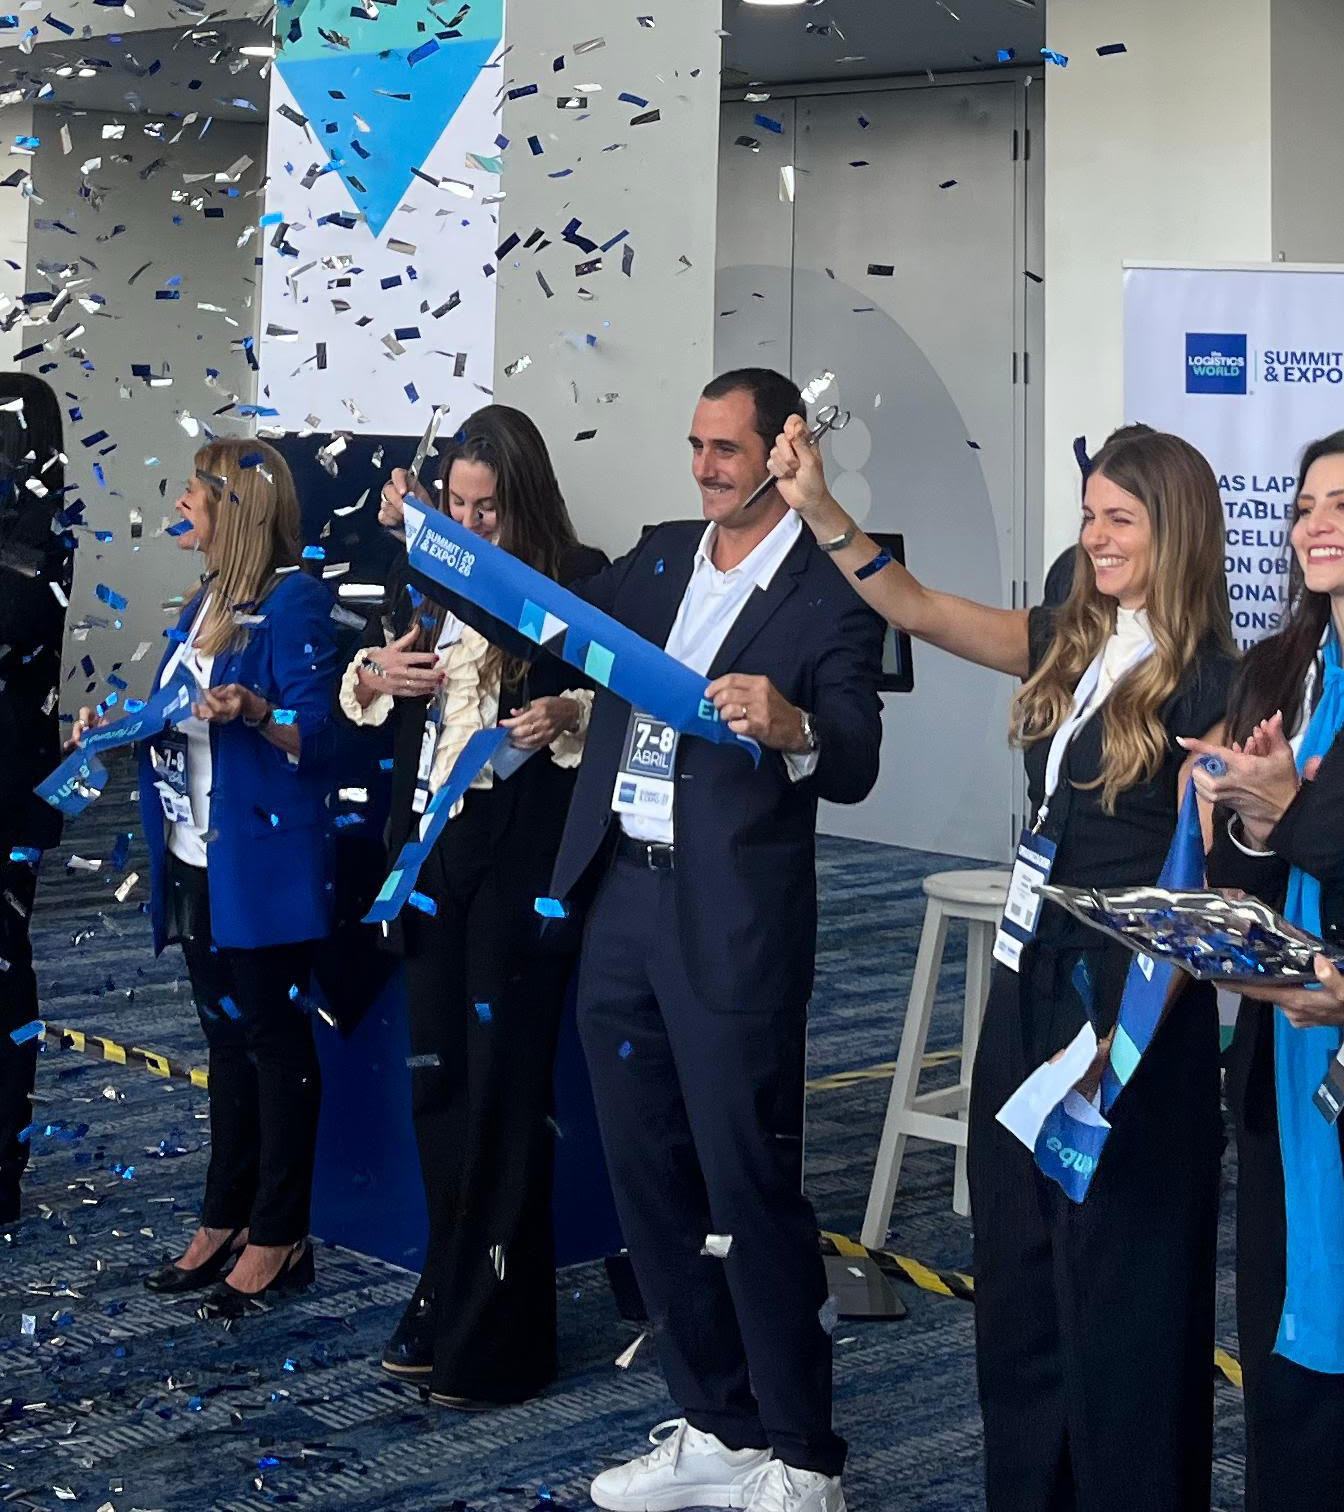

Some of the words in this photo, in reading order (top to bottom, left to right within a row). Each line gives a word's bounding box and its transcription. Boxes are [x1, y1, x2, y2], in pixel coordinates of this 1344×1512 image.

[1188, 355, 1245, 367] LOGISTICS
[1263, 350, 1344, 367] SUMMIT
[1193, 366, 1240, 377] WORLD
[1263, 366, 1280, 382] &
[1284, 367, 1344, 384] EXPO
[1252, 475, 1297, 493] LAP
[425, 529, 461, 556] SUMMIT
[1226, 529, 1292, 547] CELU
[428, 543, 457, 567] EXPO
[1230, 611, 1282, 630] ONS
[636, 722, 675, 753] 7-8
[631, 749, 669, 768] ABRIL
